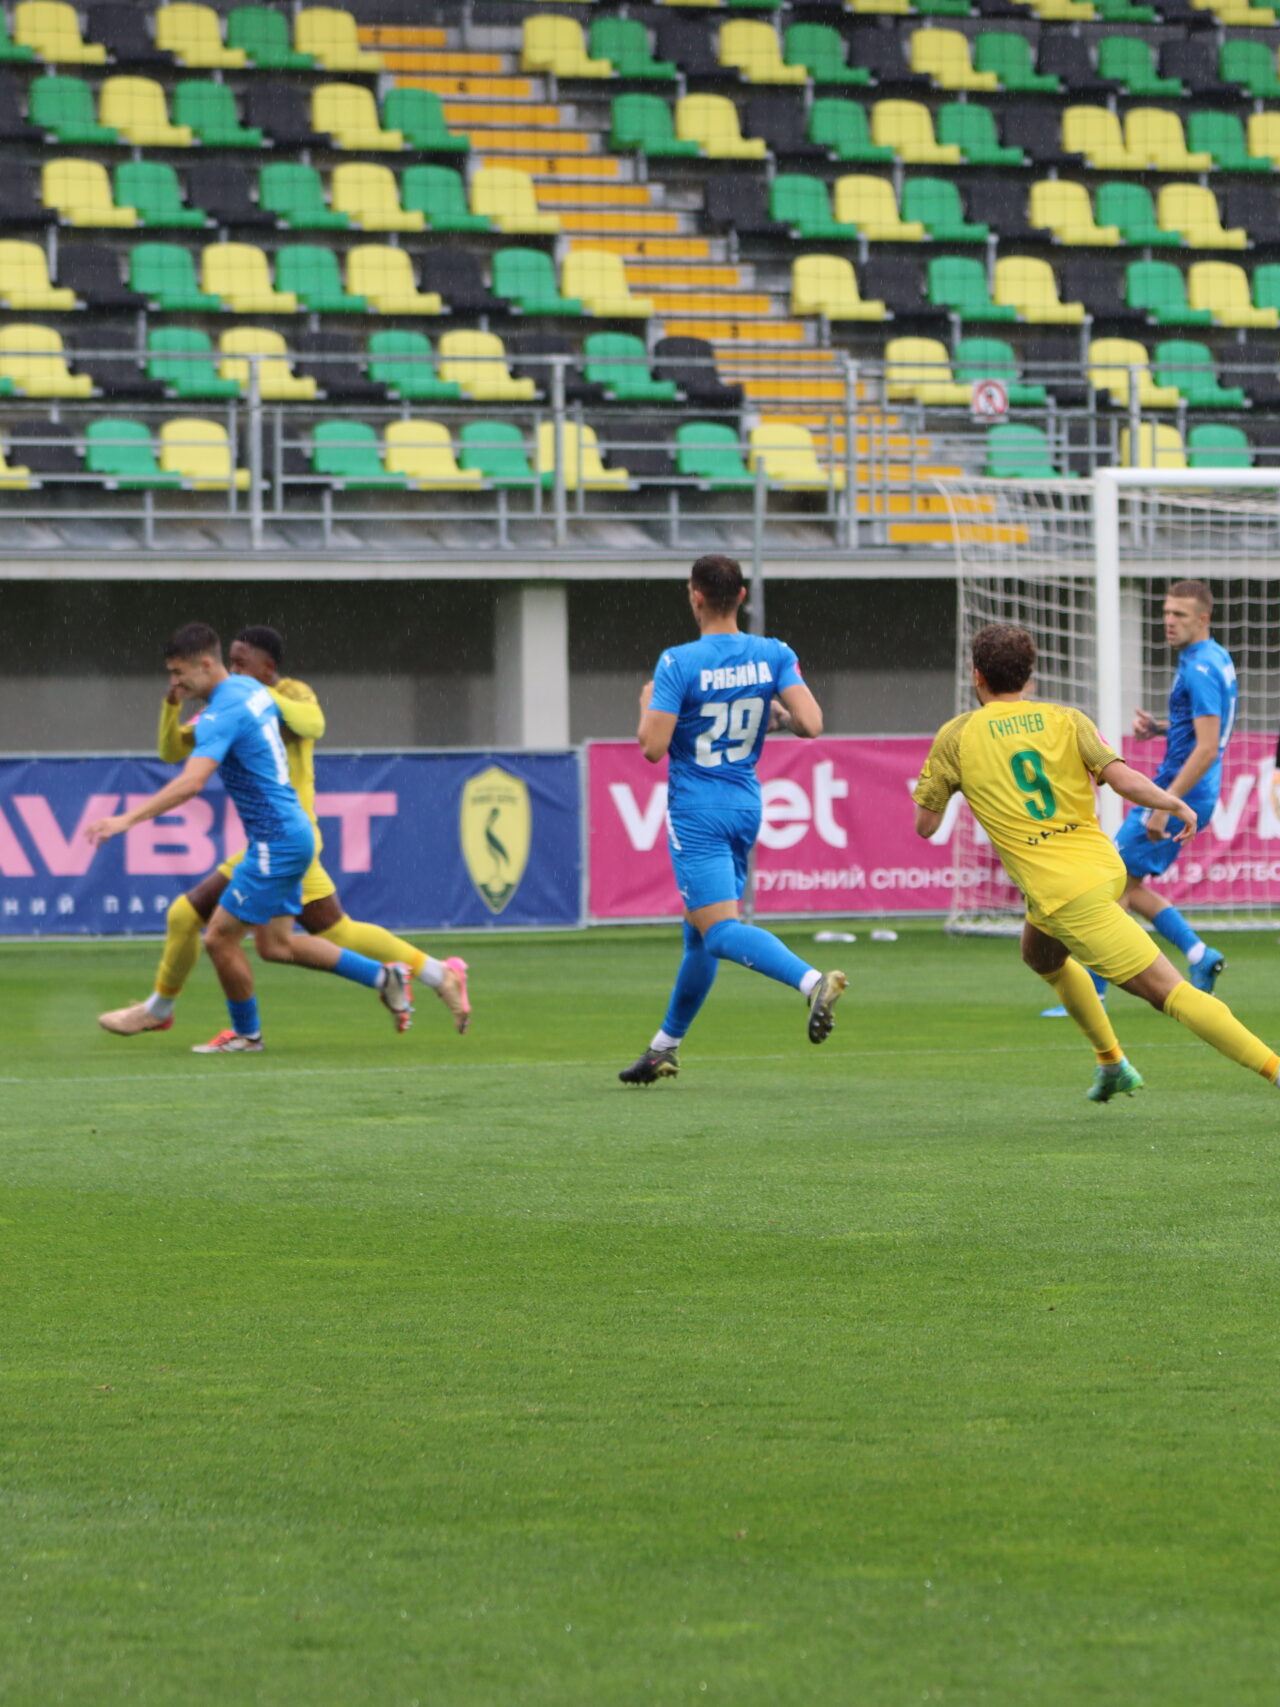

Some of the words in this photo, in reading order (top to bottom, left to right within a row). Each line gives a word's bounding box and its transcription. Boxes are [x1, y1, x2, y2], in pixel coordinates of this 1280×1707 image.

[695, 697, 764, 768] 29
[608, 760, 849, 851] vet
[1010, 750, 1057, 821] 9
[0, 793, 397, 877] VBT
[753, 864, 866, 891] ТУЛЬНИЙ
